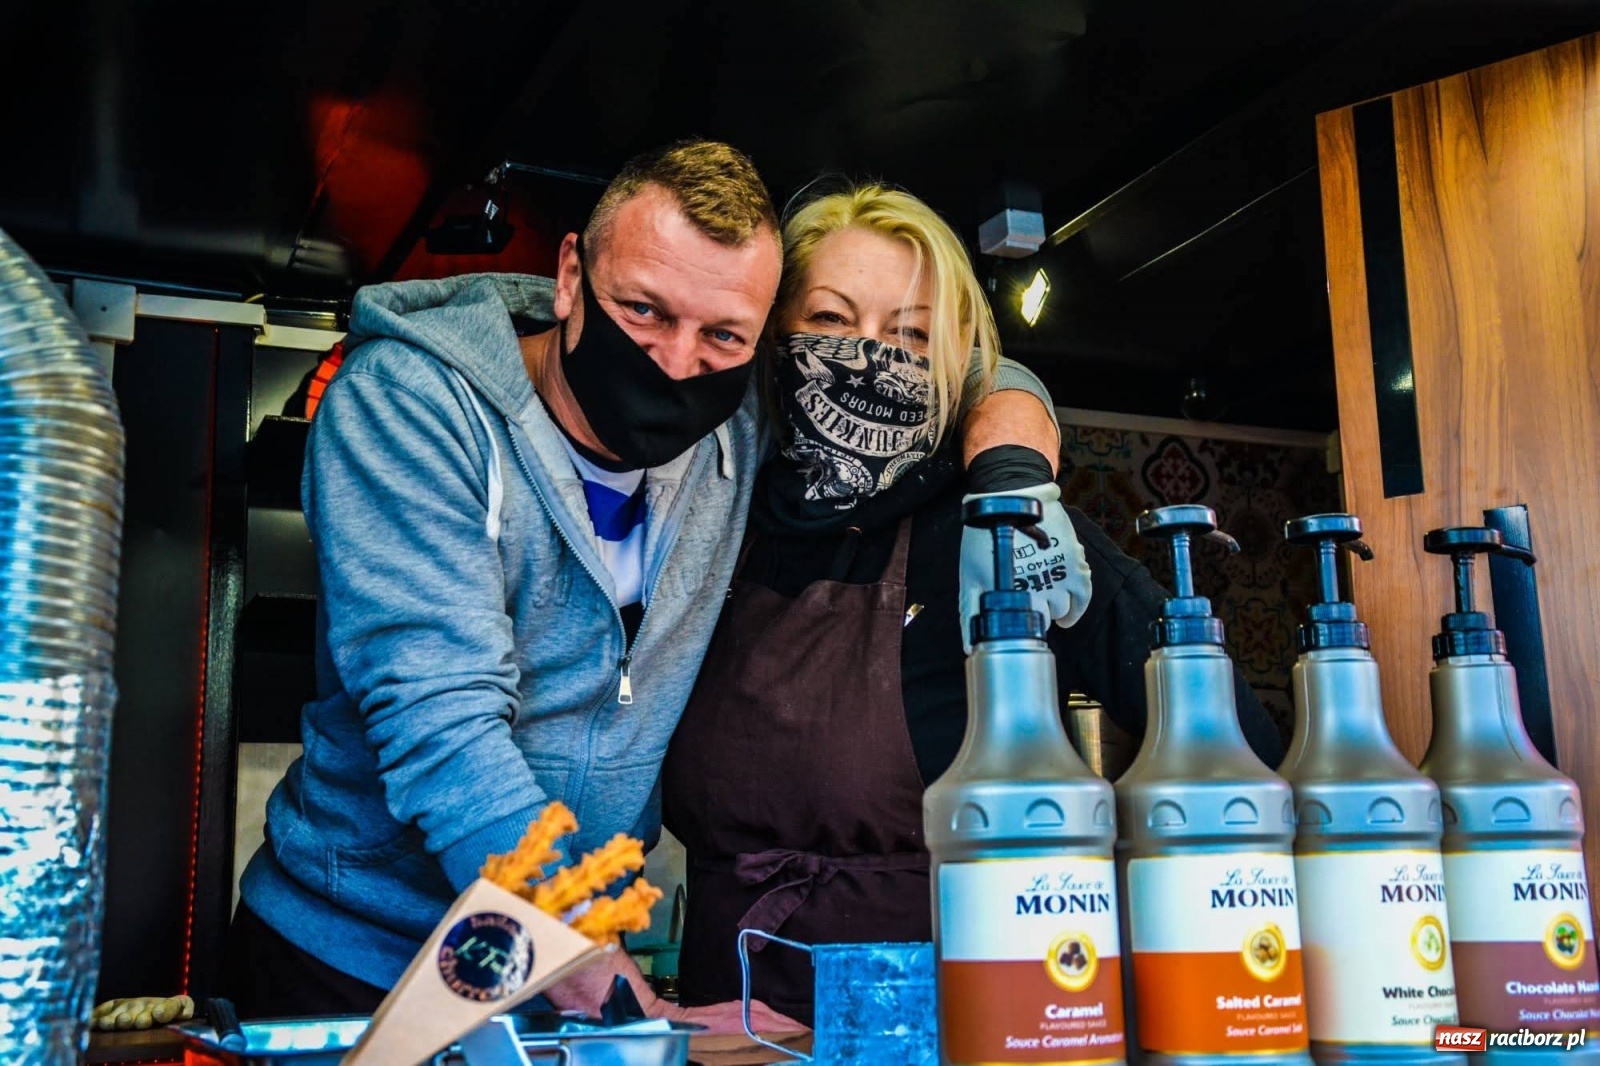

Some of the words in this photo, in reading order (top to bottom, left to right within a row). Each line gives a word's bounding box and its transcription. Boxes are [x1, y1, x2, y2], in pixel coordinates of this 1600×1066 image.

[840, 392, 893, 418] MOTORS
[805, 393, 904, 452] JUNKIES
[1027, 553, 1065, 571] KF140
[1211, 888, 1294, 908] MONIN
[1513, 882, 1589, 901] MONIN
[1016, 893, 1110, 915] MONIN
[1382, 985, 1424, 999] White
[1505, 980, 1576, 996] Chocolate
[1216, 994, 1260, 1010] Salted
[1005, 1034, 1040, 1049] Sauce
